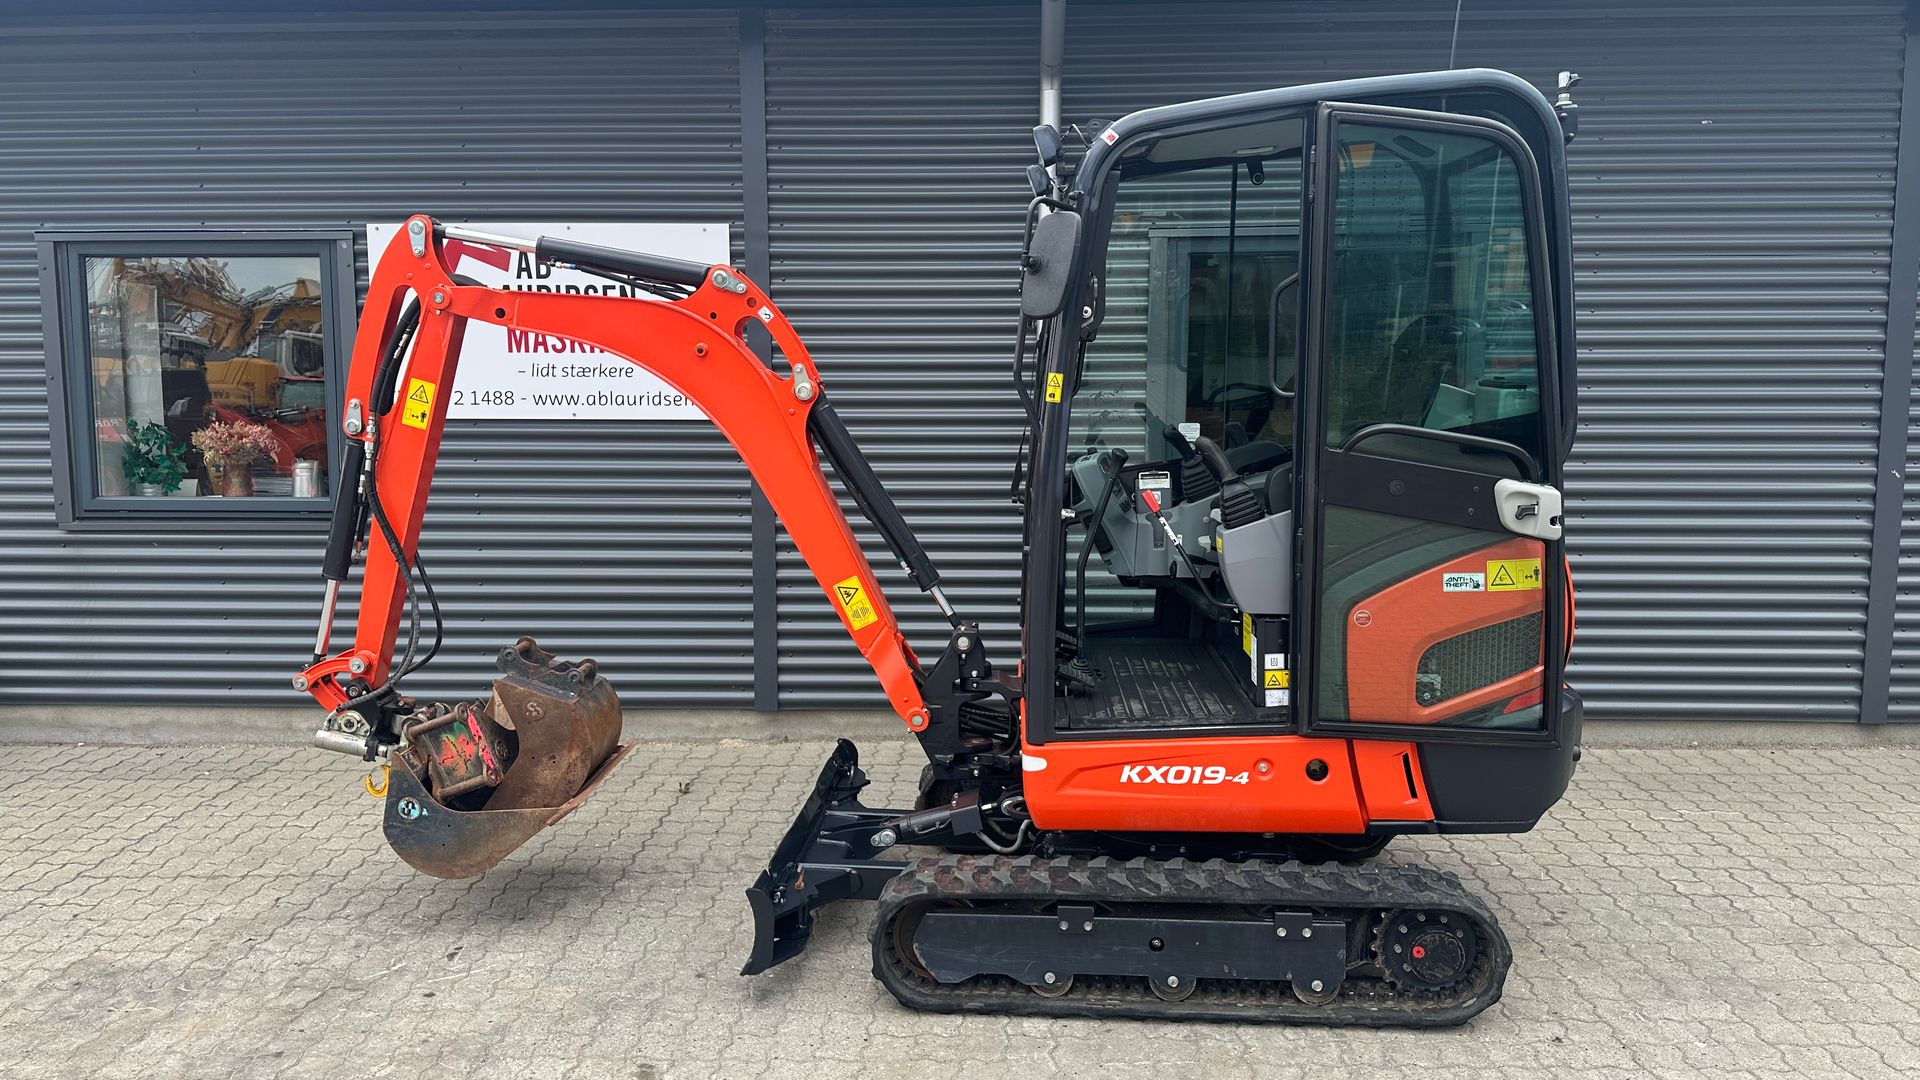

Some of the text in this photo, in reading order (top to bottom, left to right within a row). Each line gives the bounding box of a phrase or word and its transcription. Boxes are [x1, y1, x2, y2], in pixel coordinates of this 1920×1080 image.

[531, 362, 557, 378] lidt
[561, 362, 635, 378] stærkere
[470, 390, 515, 406] 1488
[1119, 765, 1249, 785] KX019-4
